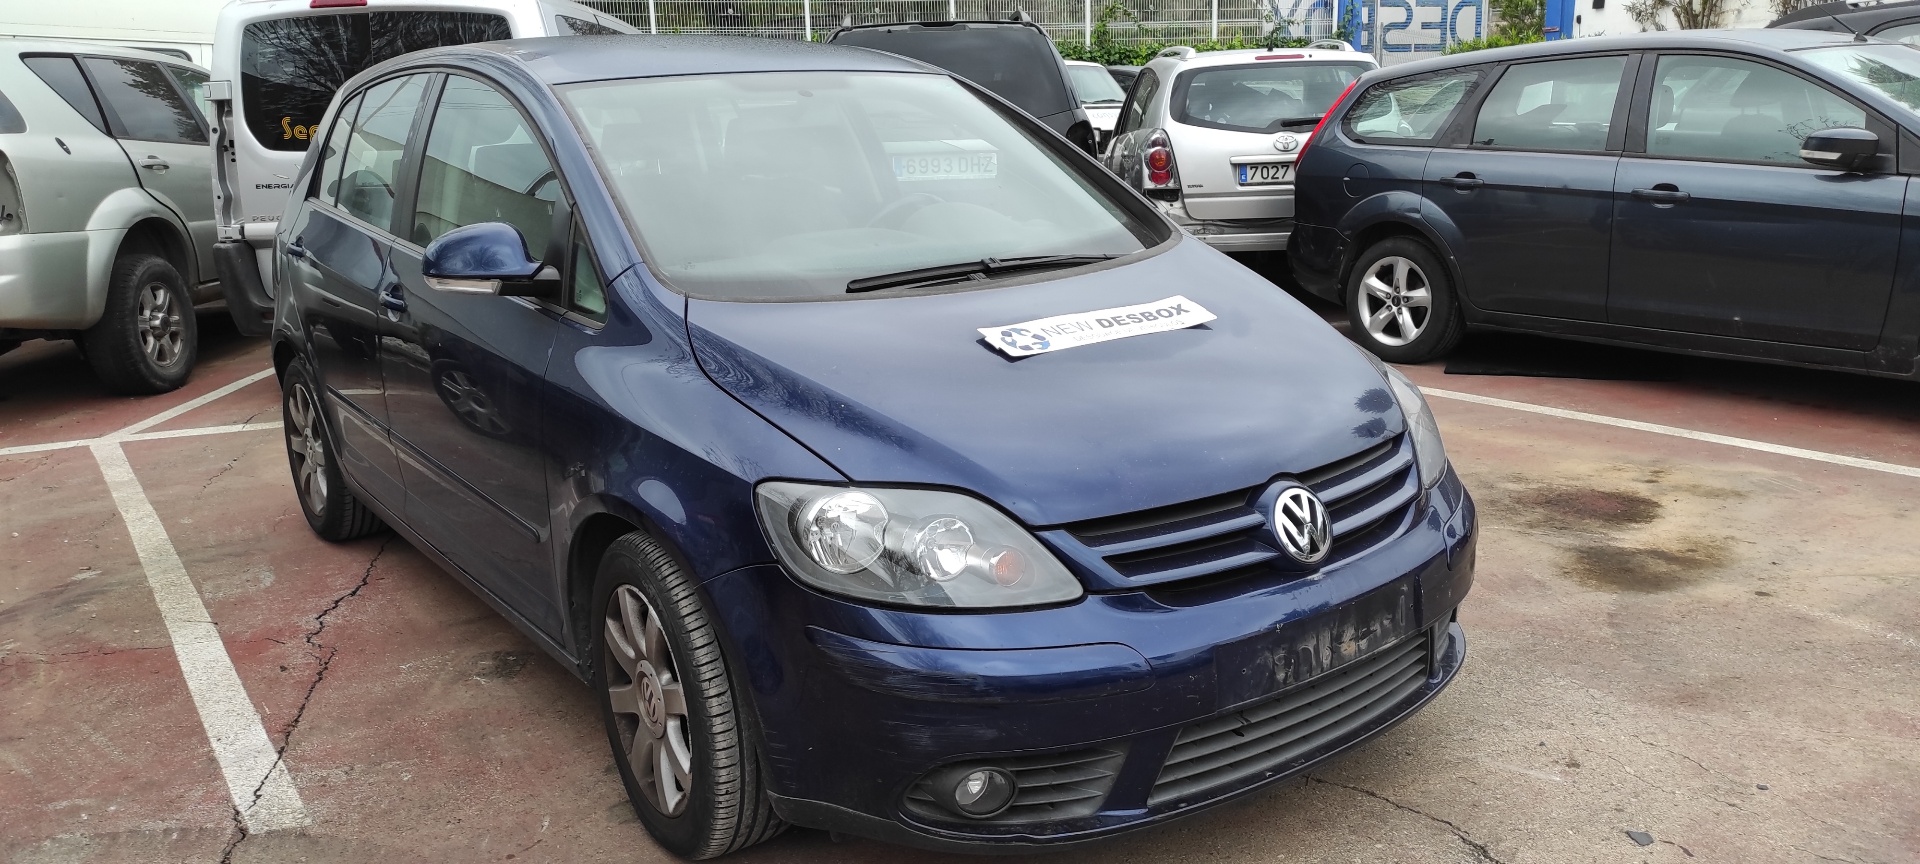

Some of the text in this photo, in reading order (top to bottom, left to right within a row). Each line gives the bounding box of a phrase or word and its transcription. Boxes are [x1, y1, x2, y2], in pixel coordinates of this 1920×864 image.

[906, 158, 953, 174] 6993
[1249, 165, 1290, 180] 7027
[1040, 320, 1093, 337] NEW
[1095, 303, 1190, 329] DESBOX
